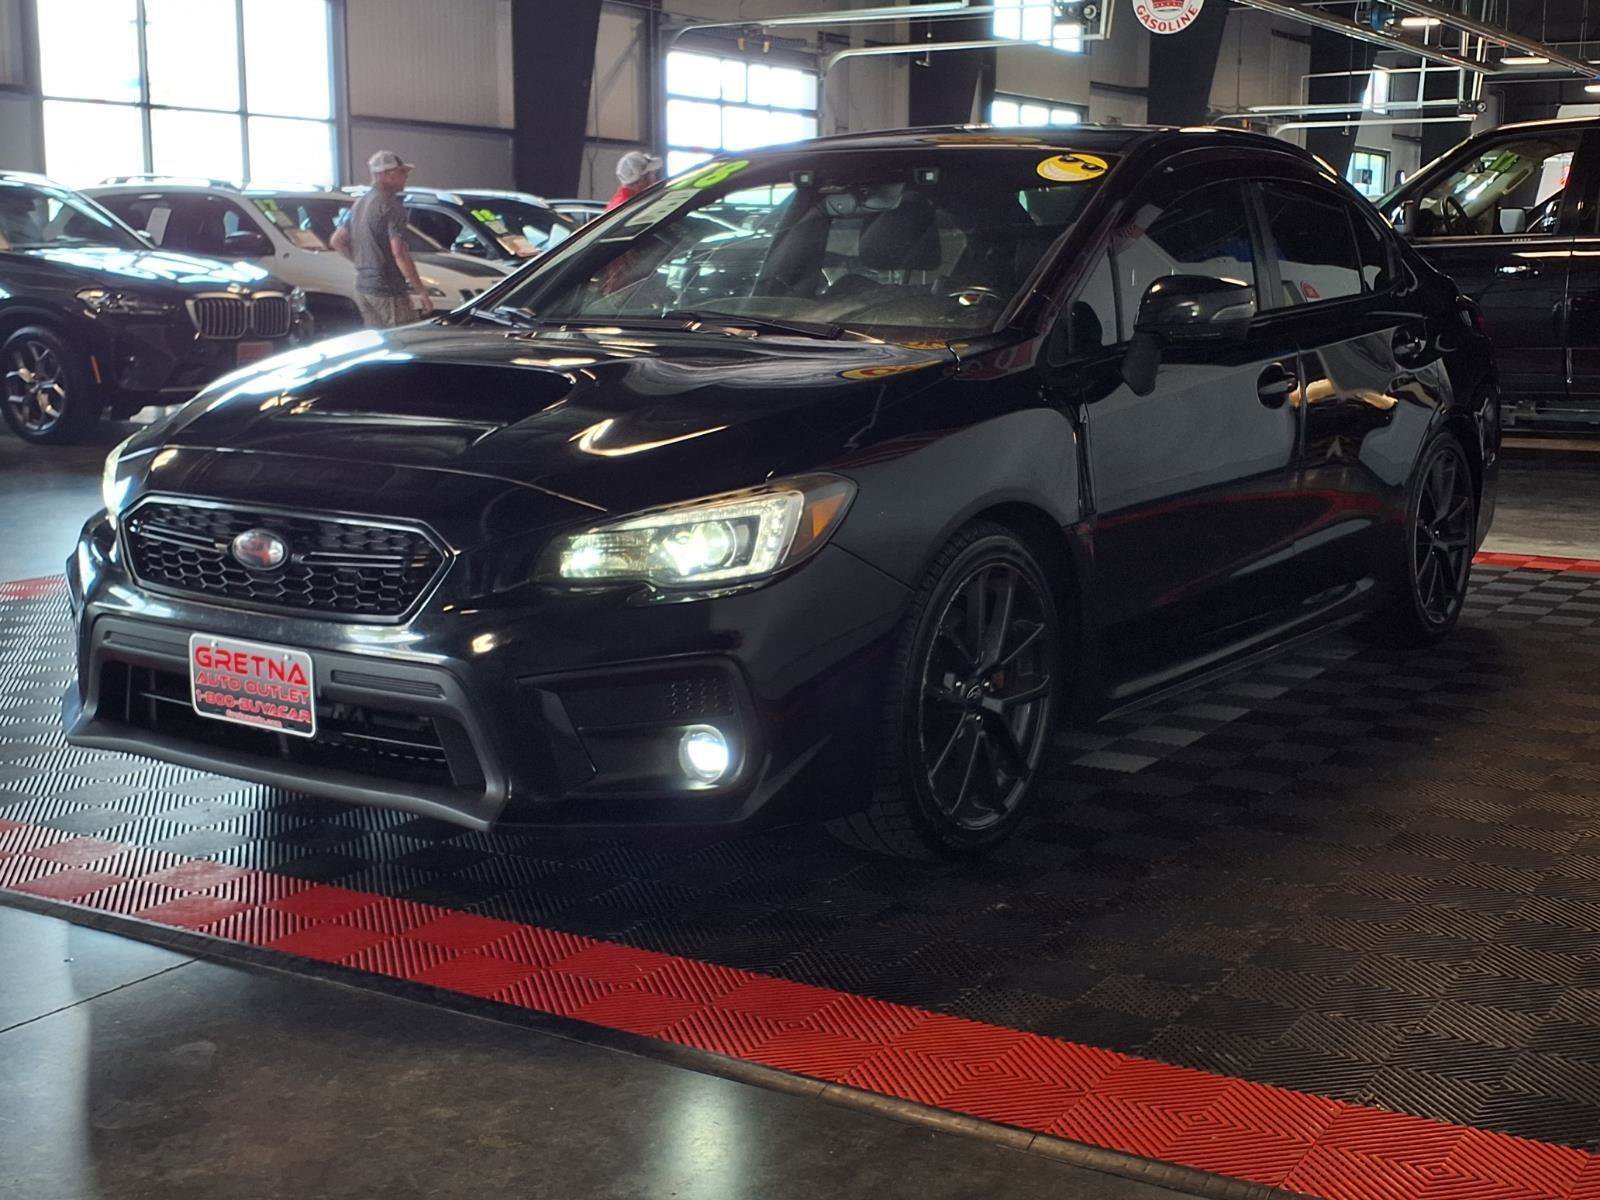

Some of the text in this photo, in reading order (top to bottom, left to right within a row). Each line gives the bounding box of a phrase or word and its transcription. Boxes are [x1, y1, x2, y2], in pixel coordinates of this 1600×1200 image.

[1136, 4, 1198, 32] GASOLINE
[195, 645, 308, 686] GRETNA
[196, 670, 310, 704] AUTO OUTLET
[195, 688, 312, 723] 1-800-BUYACAR
